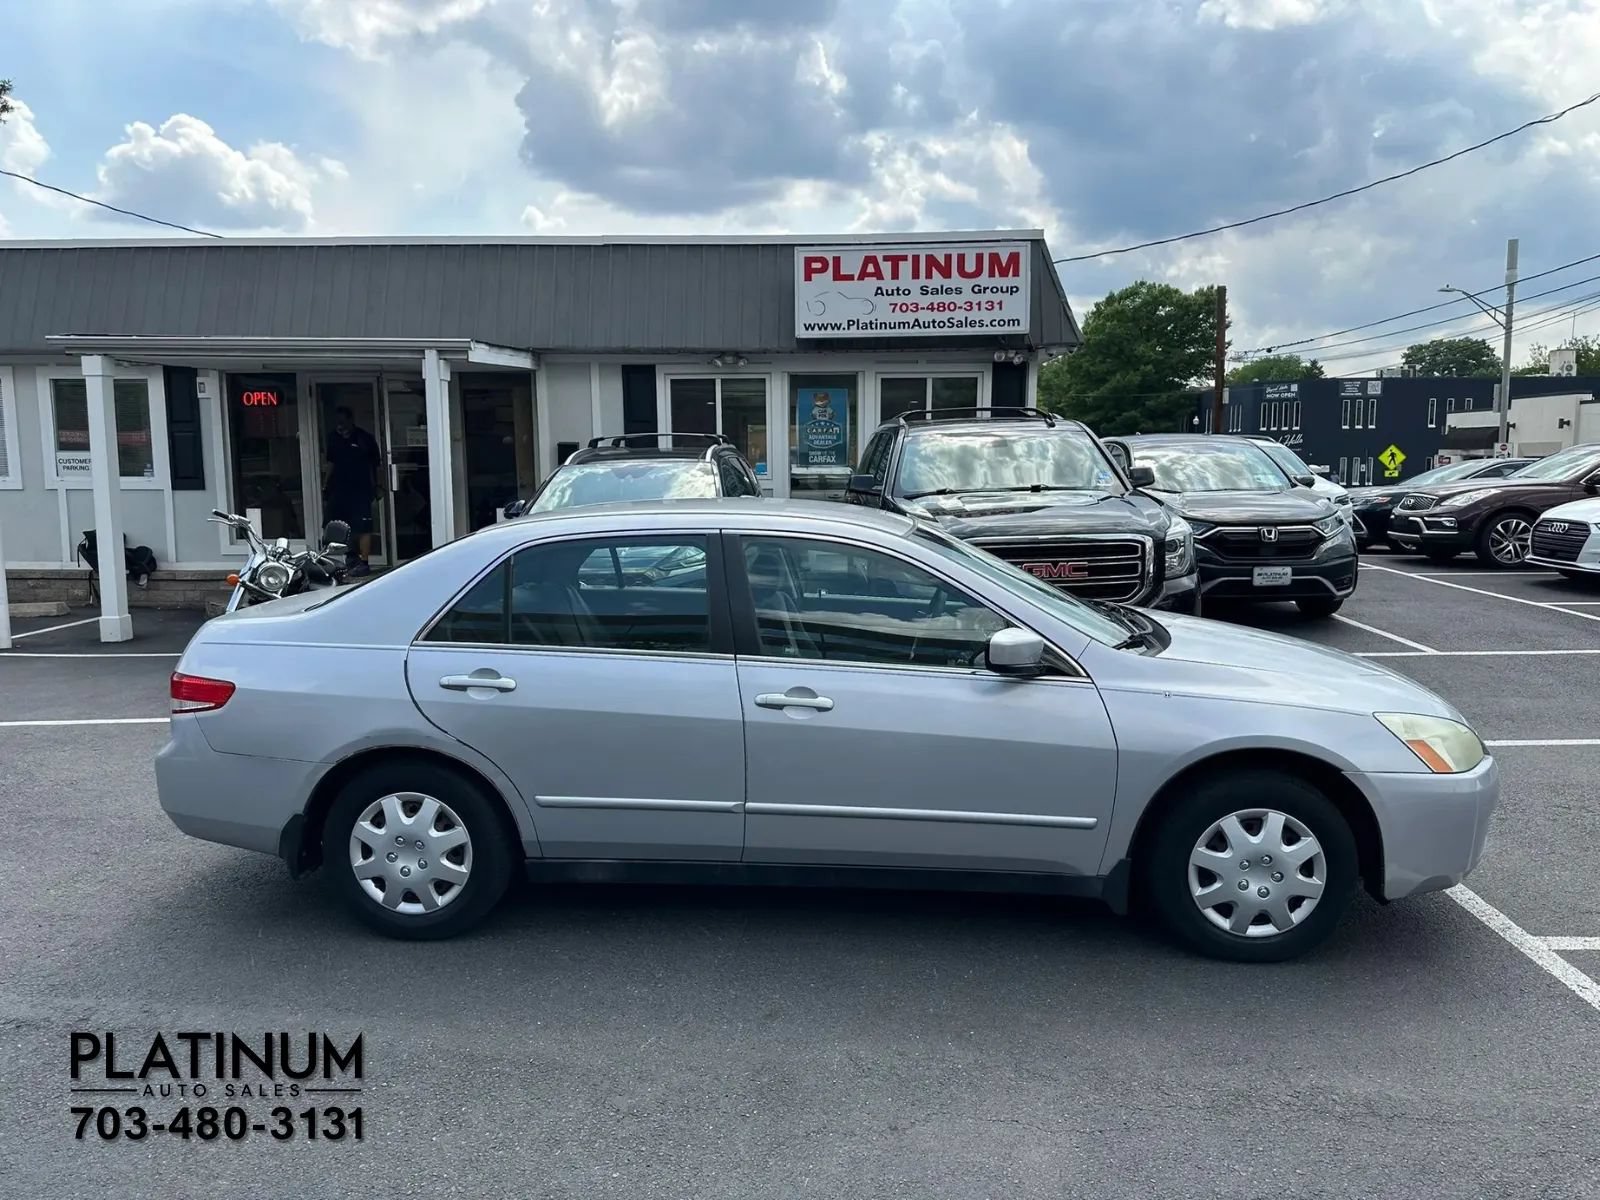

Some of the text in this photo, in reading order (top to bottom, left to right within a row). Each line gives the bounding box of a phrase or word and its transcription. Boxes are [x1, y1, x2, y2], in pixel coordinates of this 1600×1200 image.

[803, 252, 1020, 282] PLATINUM
[874, 284, 1020, 297] Auto Sales Group
[889, 300, 1004, 314] 703-480-3131
[803, 316, 1021, 332] www.PlatinumAutoSales.com
[242, 391, 278, 406] OPEN
[1023, 561, 1089, 578] GMC
